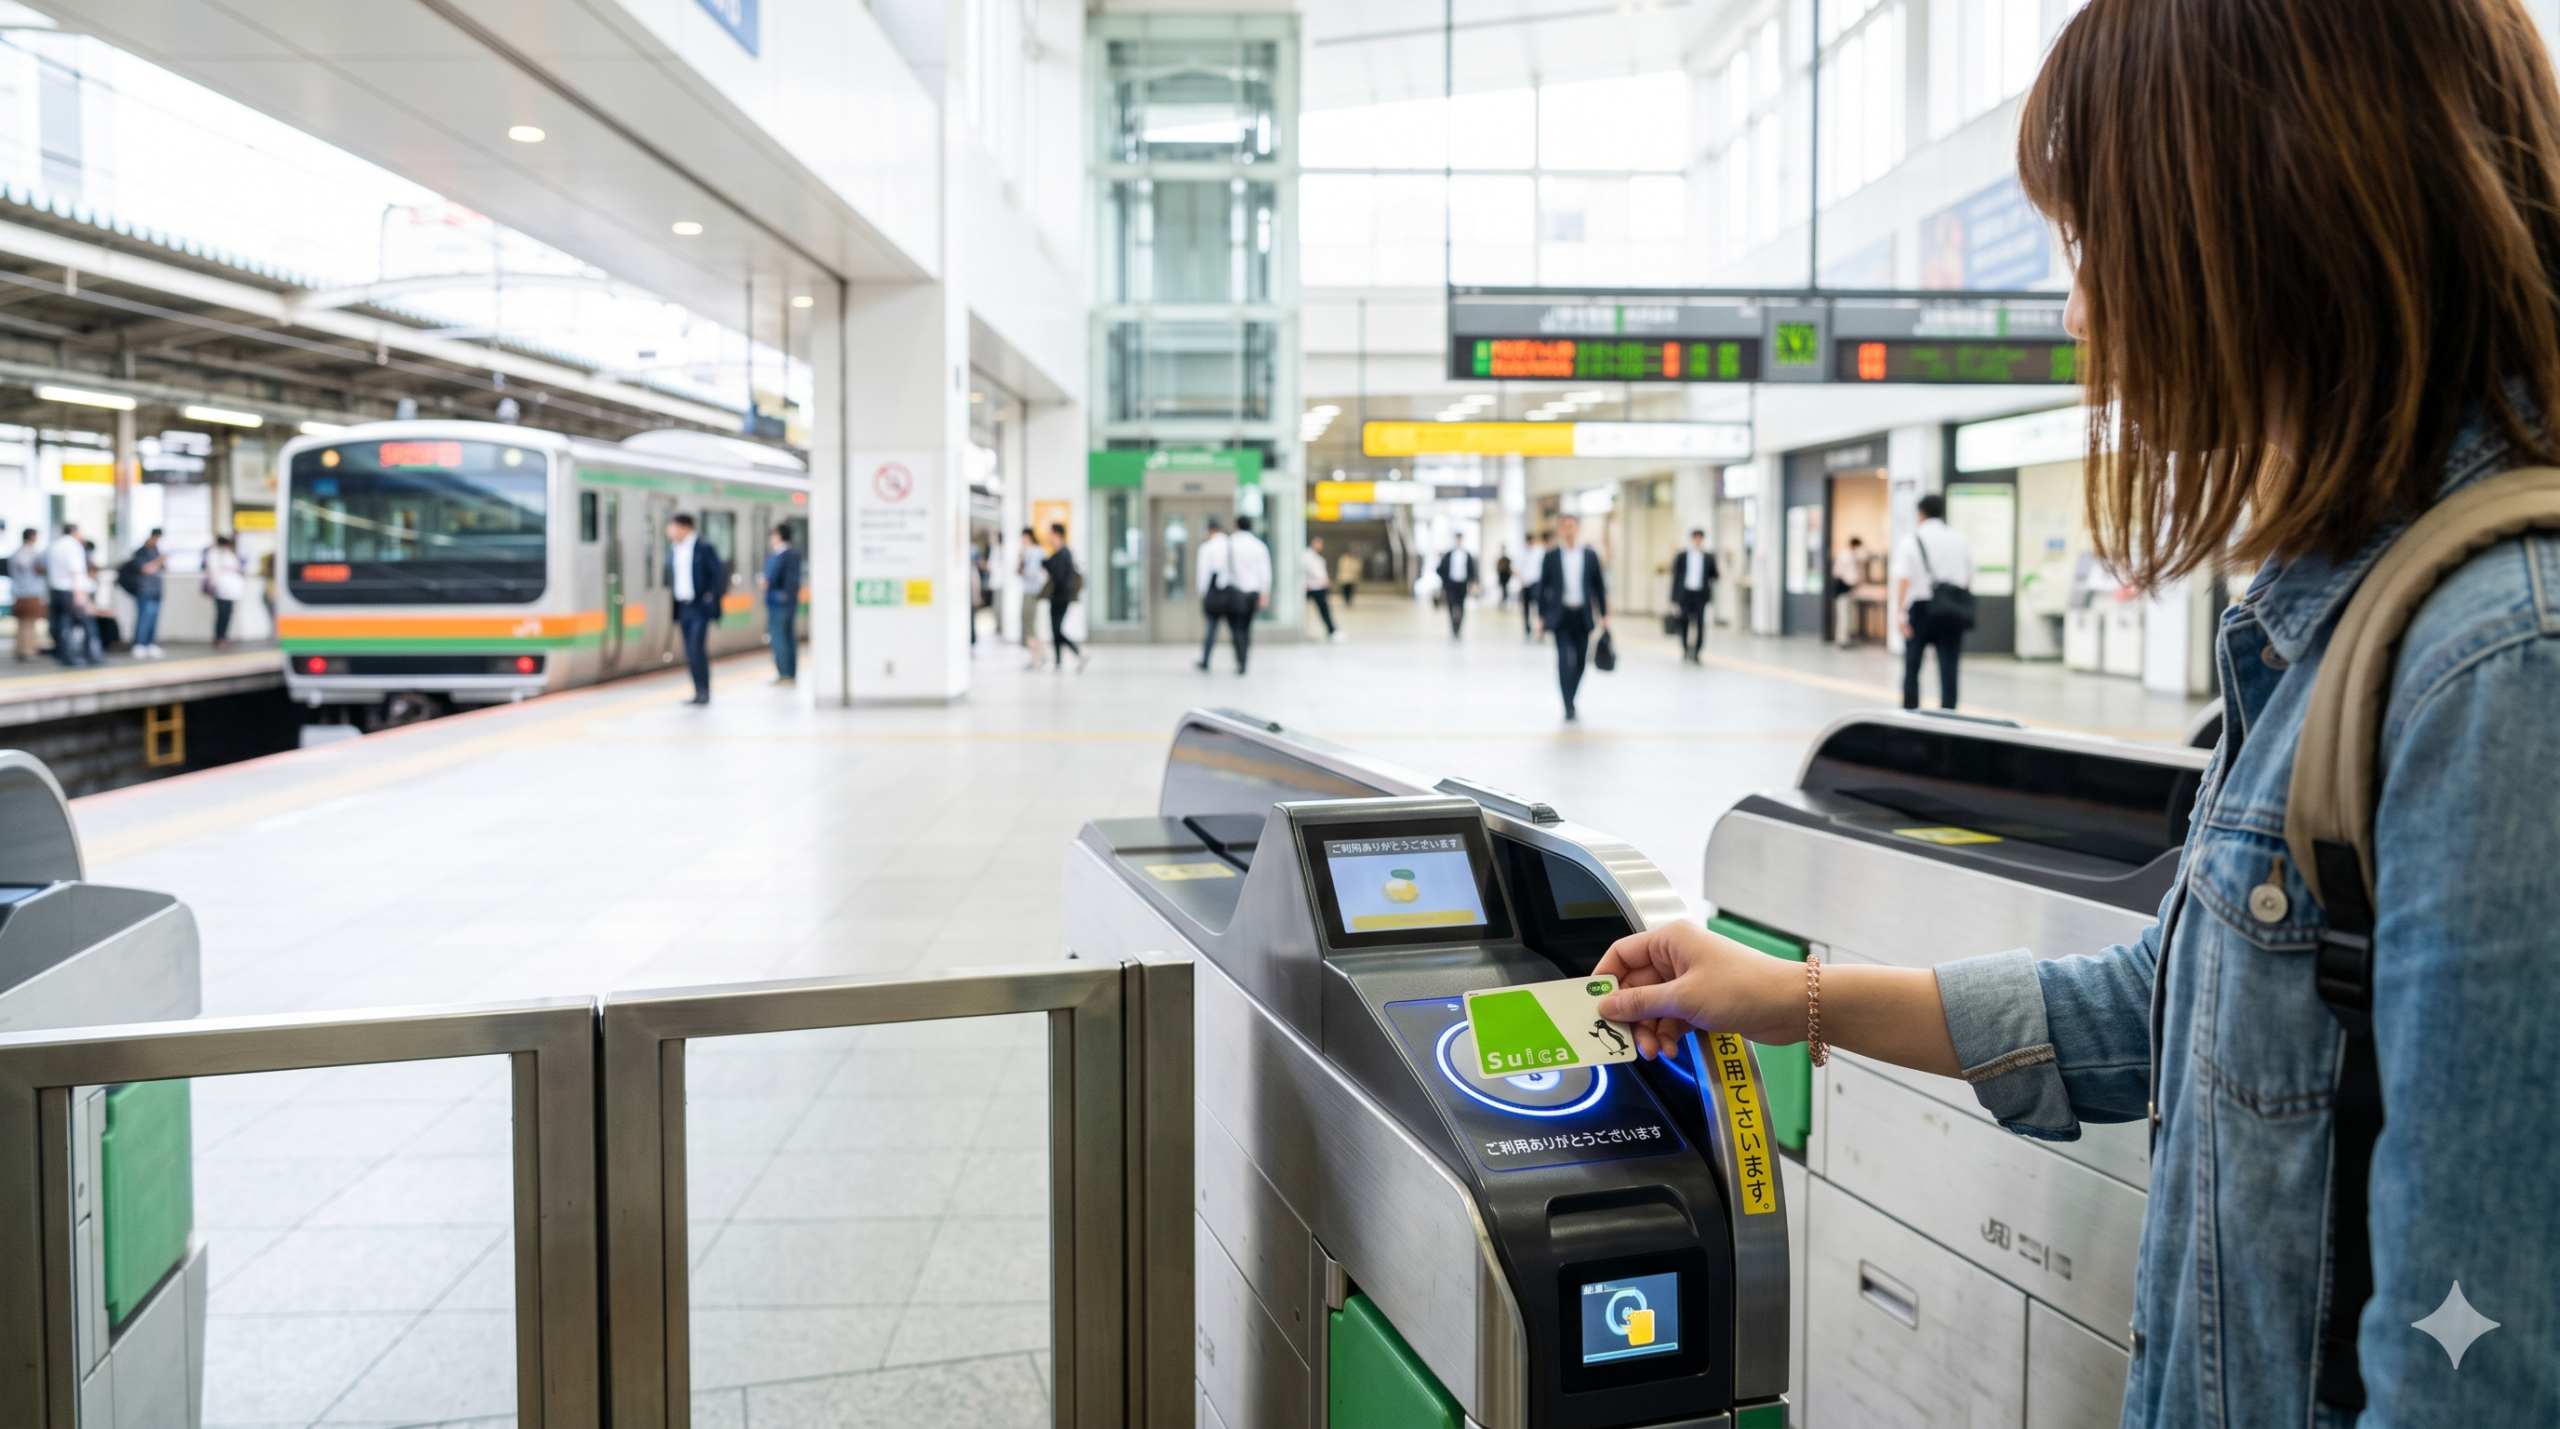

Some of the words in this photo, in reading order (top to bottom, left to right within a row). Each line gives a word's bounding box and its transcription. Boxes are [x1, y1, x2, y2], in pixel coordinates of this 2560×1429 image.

[1487, 1047, 1569, 1070] Suica
[1485, 1125, 1662, 1156] ご利用ありがとうございます
